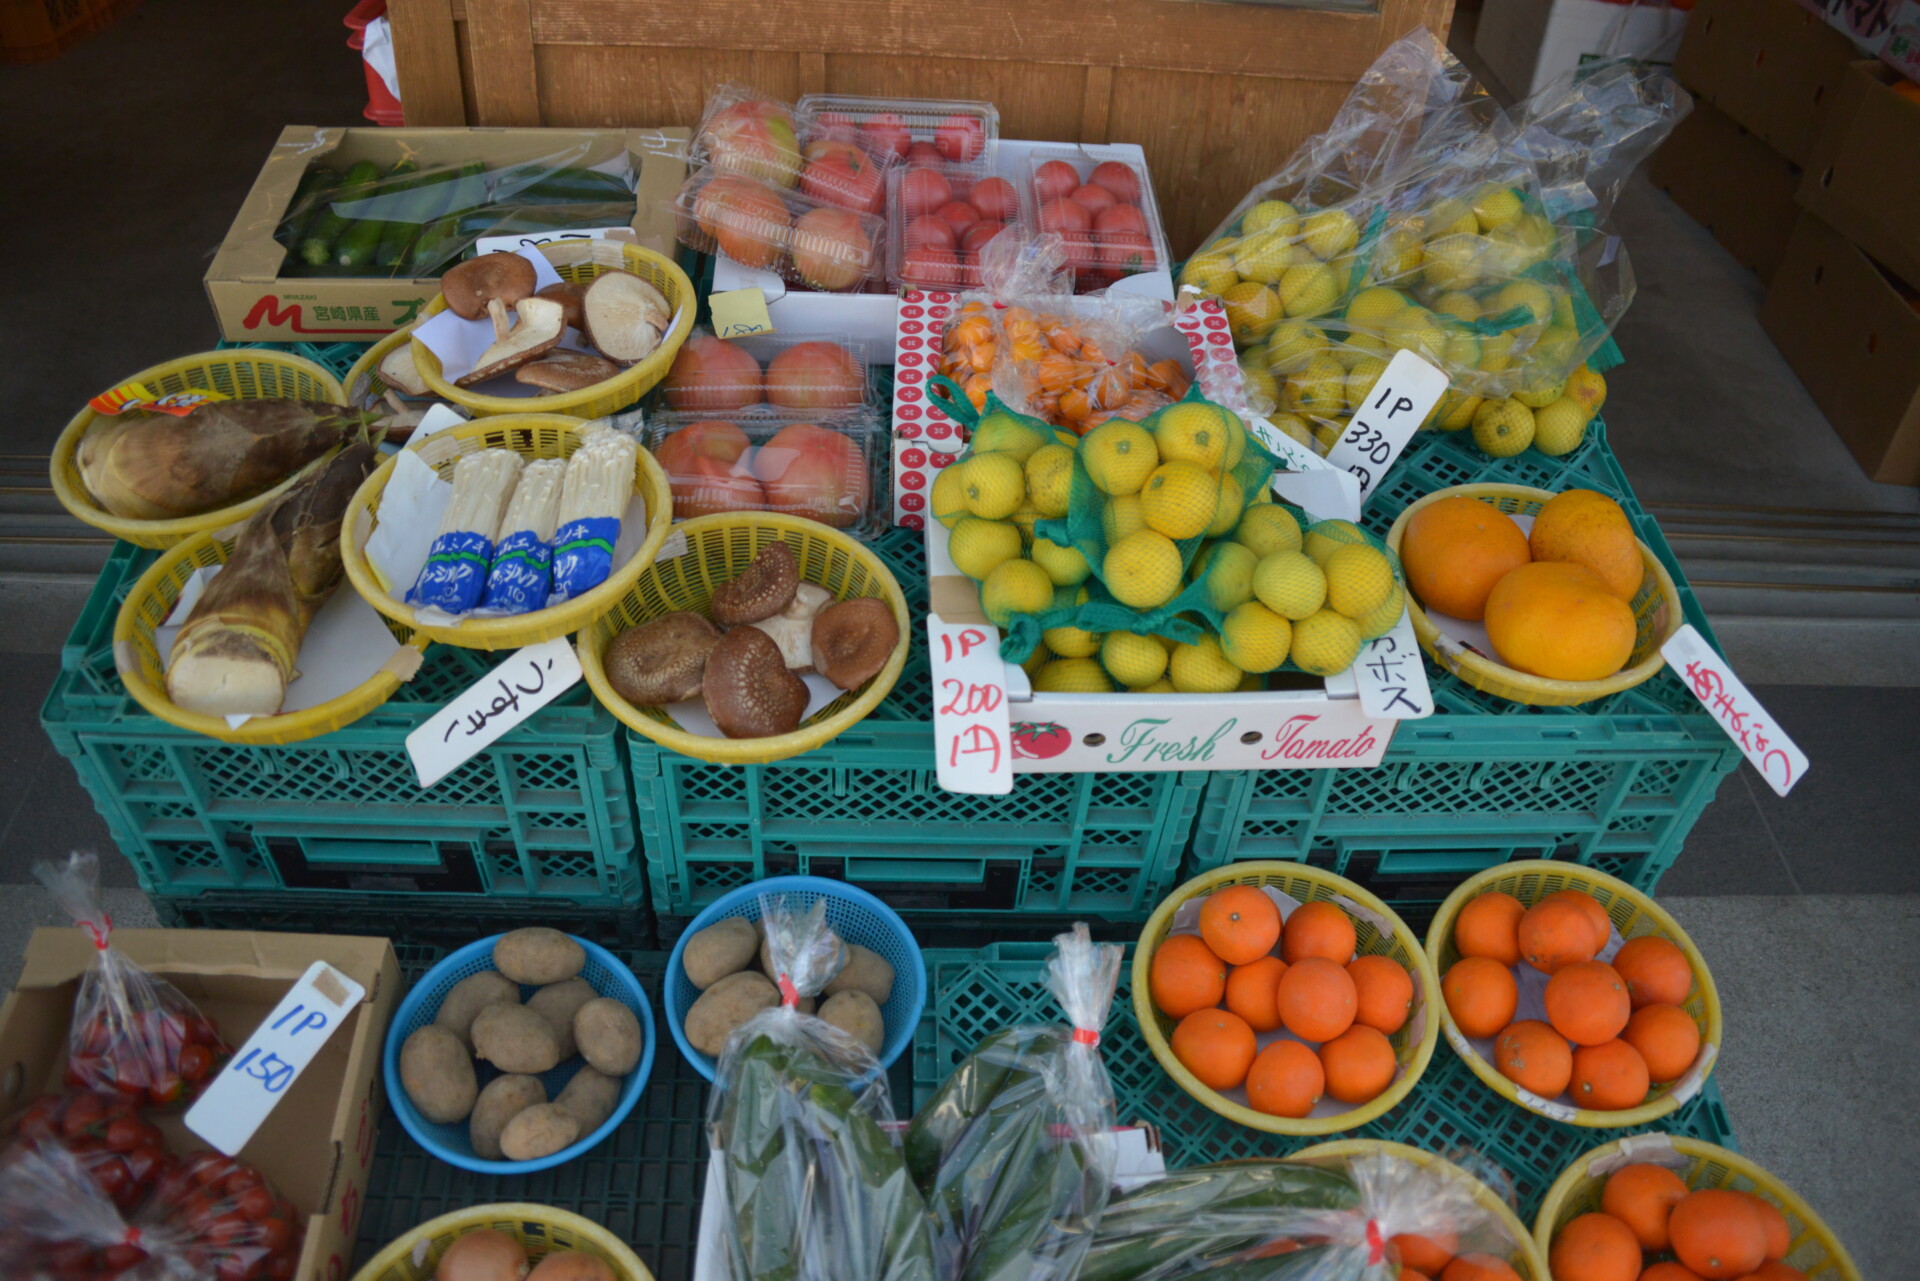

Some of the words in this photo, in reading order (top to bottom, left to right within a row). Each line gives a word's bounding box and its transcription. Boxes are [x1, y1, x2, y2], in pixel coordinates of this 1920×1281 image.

[313, 306, 380, 321] 宮崎県産
[1375, 387, 1413, 419] 1P
[1345, 421, 1391, 465] 330
[941, 629, 987, 663] 1P
[1366, 634, 1422, 714] カボス
[940, 679, 1002, 716] 200
[1107, 717, 1238, 764] Fresh
[1261, 714, 1376, 760] Tomato
[1686, 661, 1791, 787] あまなつ
[950, 724, 1001, 774] 円
[271, 1004, 327, 1036] 1P
[233, 1048, 295, 1093] 150
